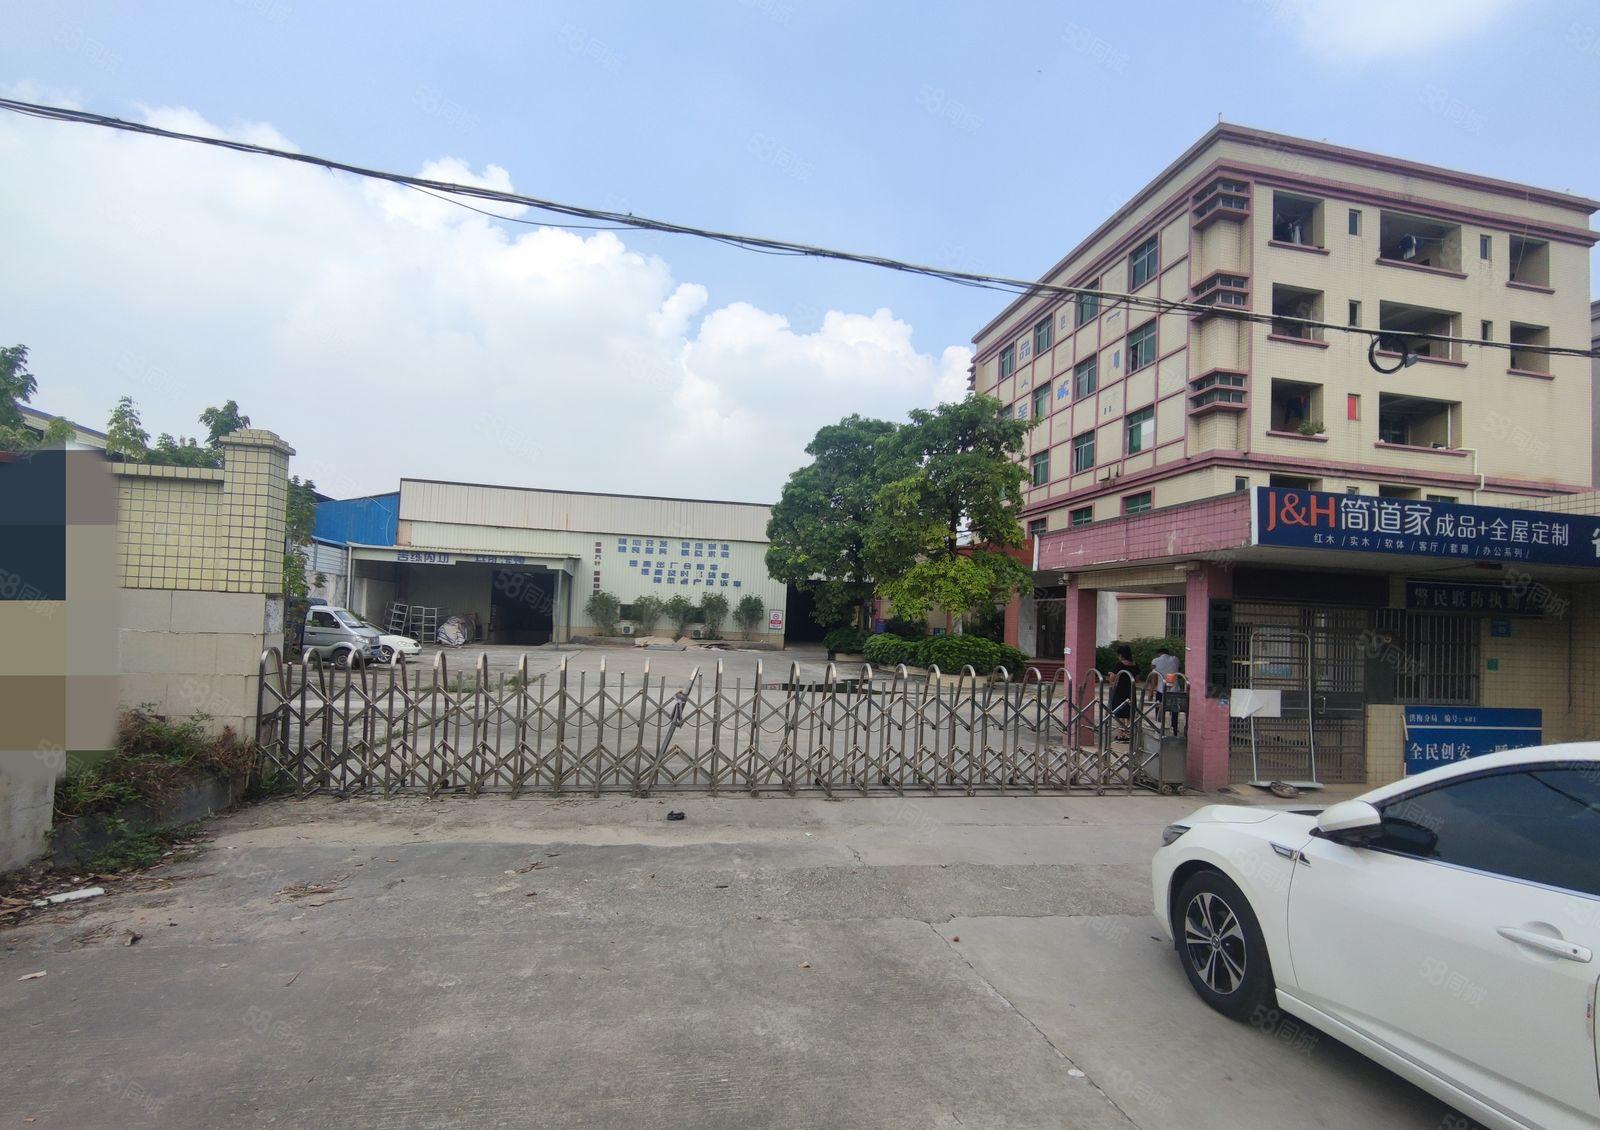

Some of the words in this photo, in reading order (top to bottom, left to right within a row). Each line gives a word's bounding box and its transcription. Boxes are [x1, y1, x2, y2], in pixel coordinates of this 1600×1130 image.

[1267, 491, 1335, 531] J&H
[1340, 498, 1432, 537] 简道家
[1436, 513, 1569, 548] 成品+全屋定制
[1409, 742, 1471, 761] 全民创安
